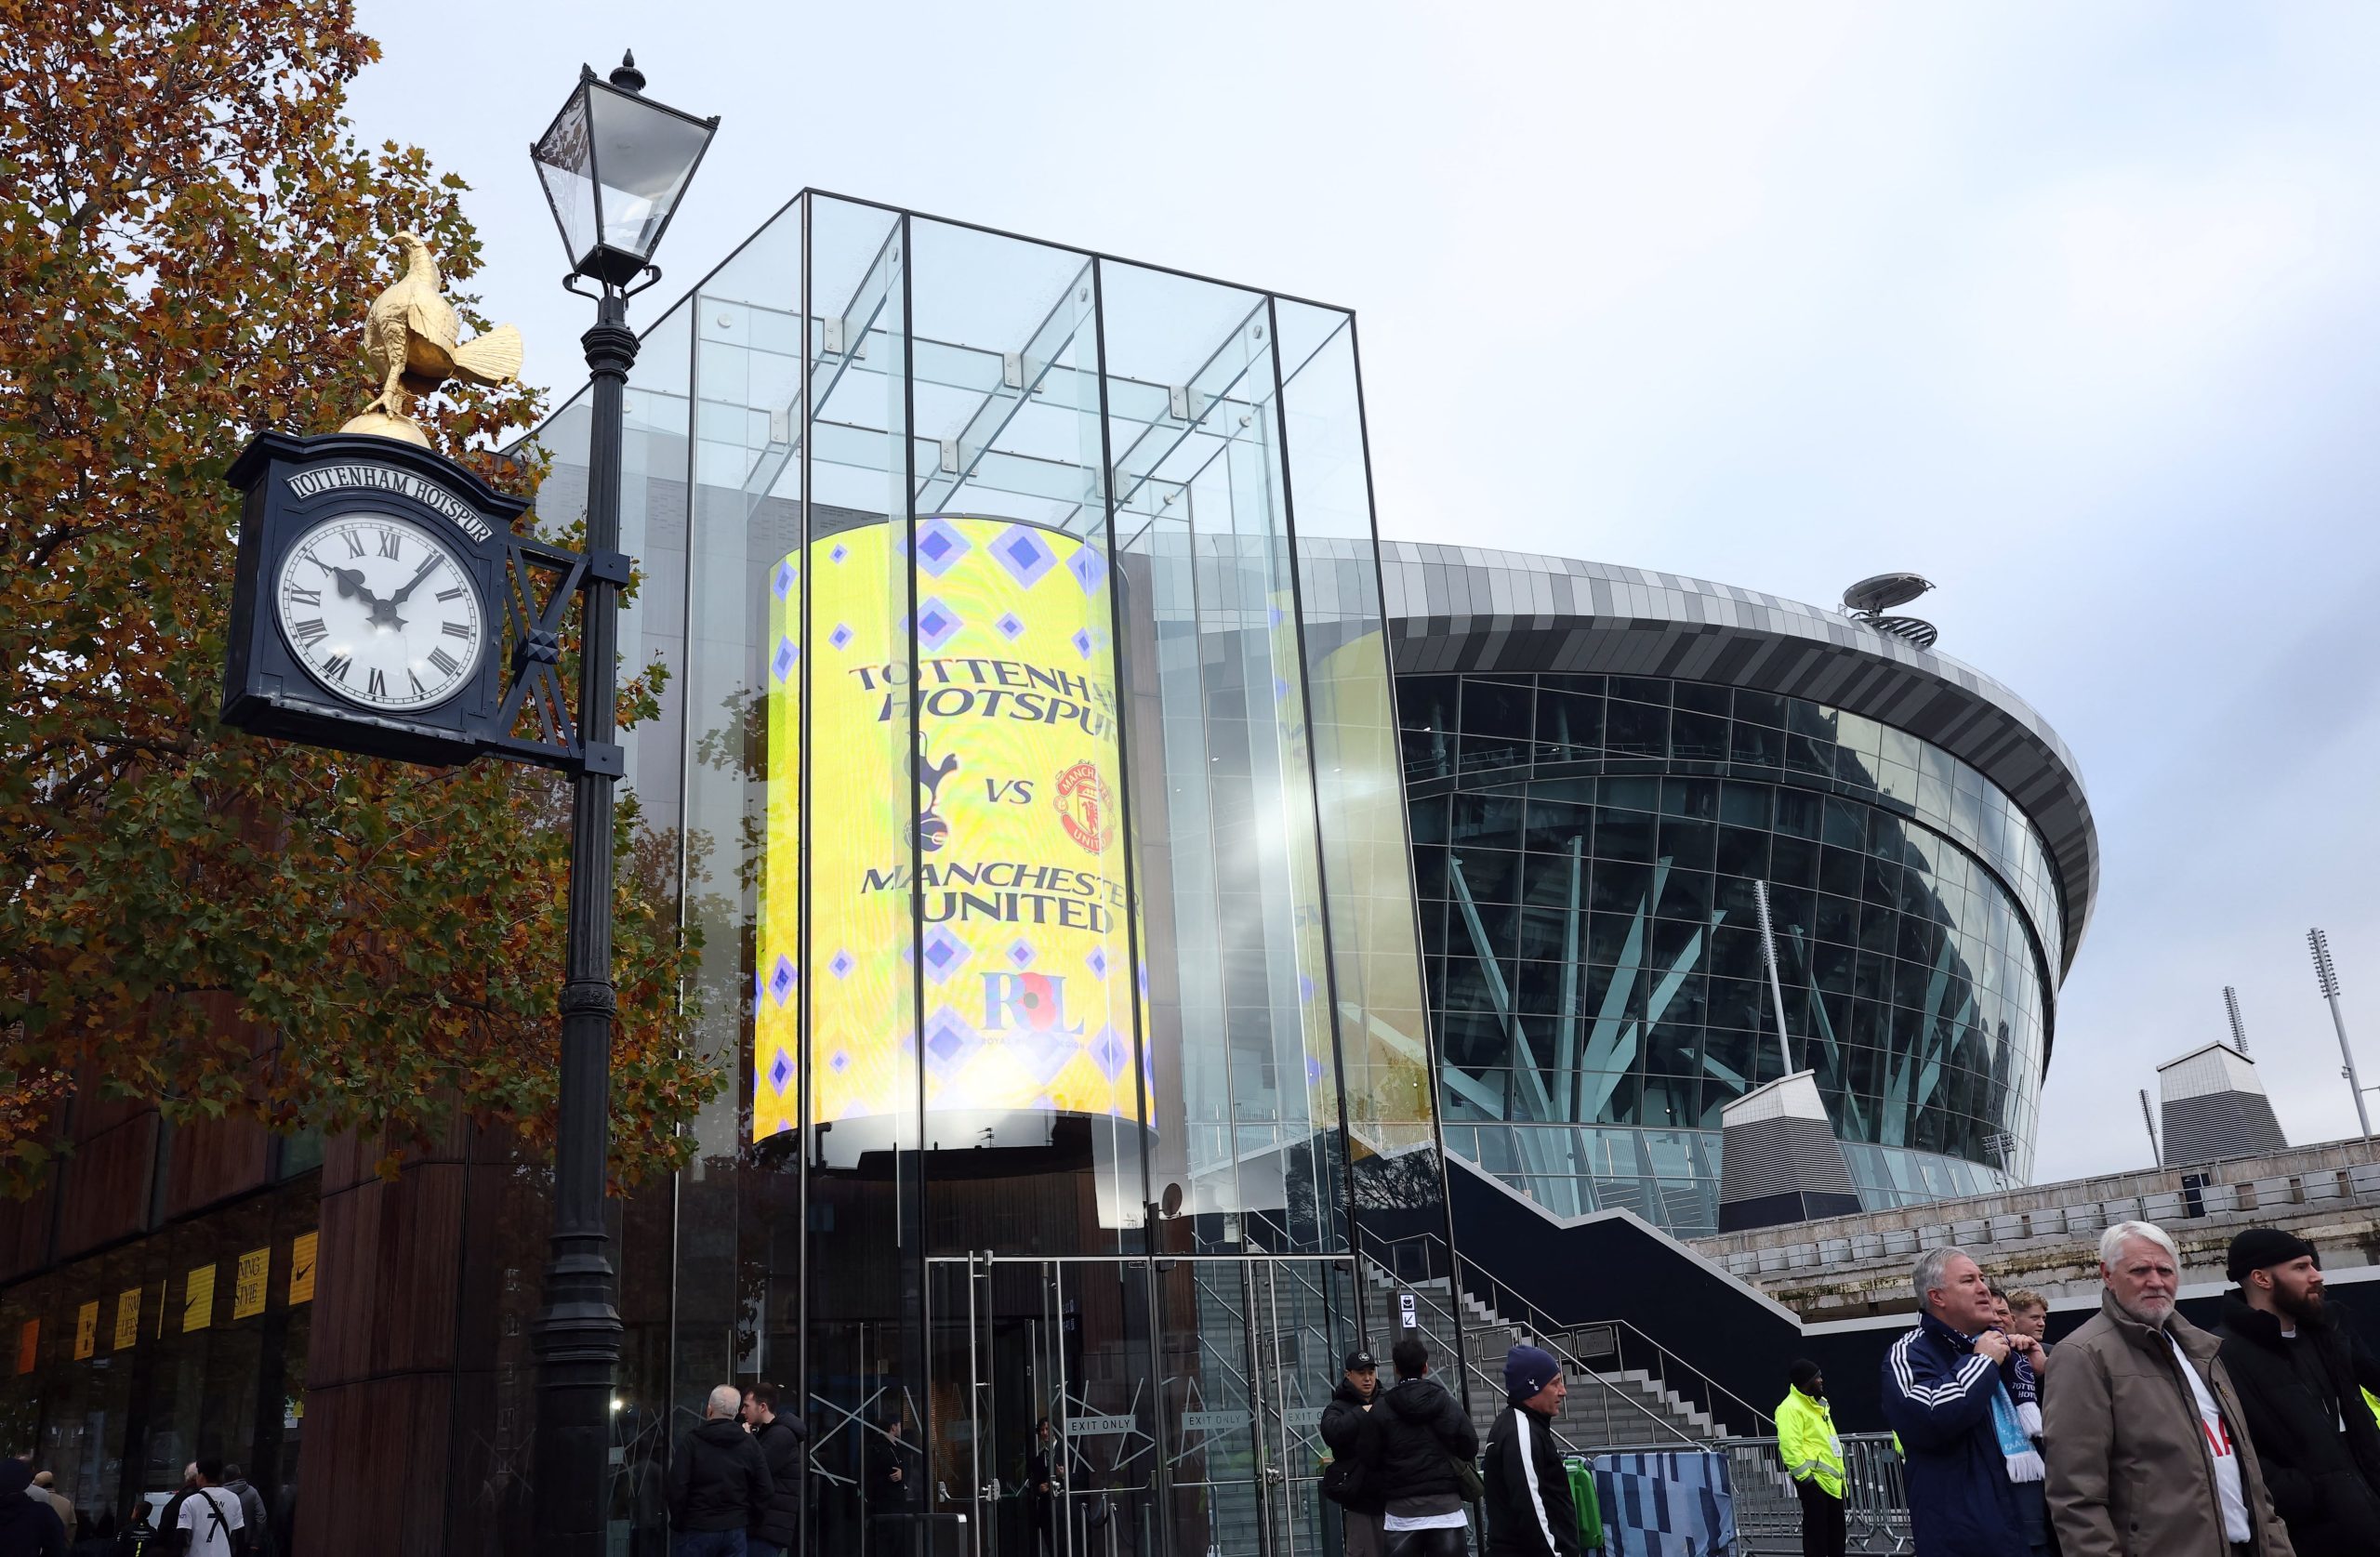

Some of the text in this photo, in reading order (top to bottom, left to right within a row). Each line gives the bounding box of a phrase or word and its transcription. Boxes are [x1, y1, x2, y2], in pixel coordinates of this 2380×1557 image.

[290, 467, 489, 541] TOTTENHAM HOTSPUR
[339, 530, 366, 560] XI
[376, 530, 401, 562] XII
[291, 582, 322, 609] IX
[985, 778, 1035, 805] VS
[907, 891, 1114, 934] UNITED
[1071, 1418, 1130, 1432] EXIT ONLY
[1189, 1415, 1242, 1426] EXIT ONLY
[1288, 1412, 1312, 1422] EXIT
[206, 1512, 224, 1543] 7
